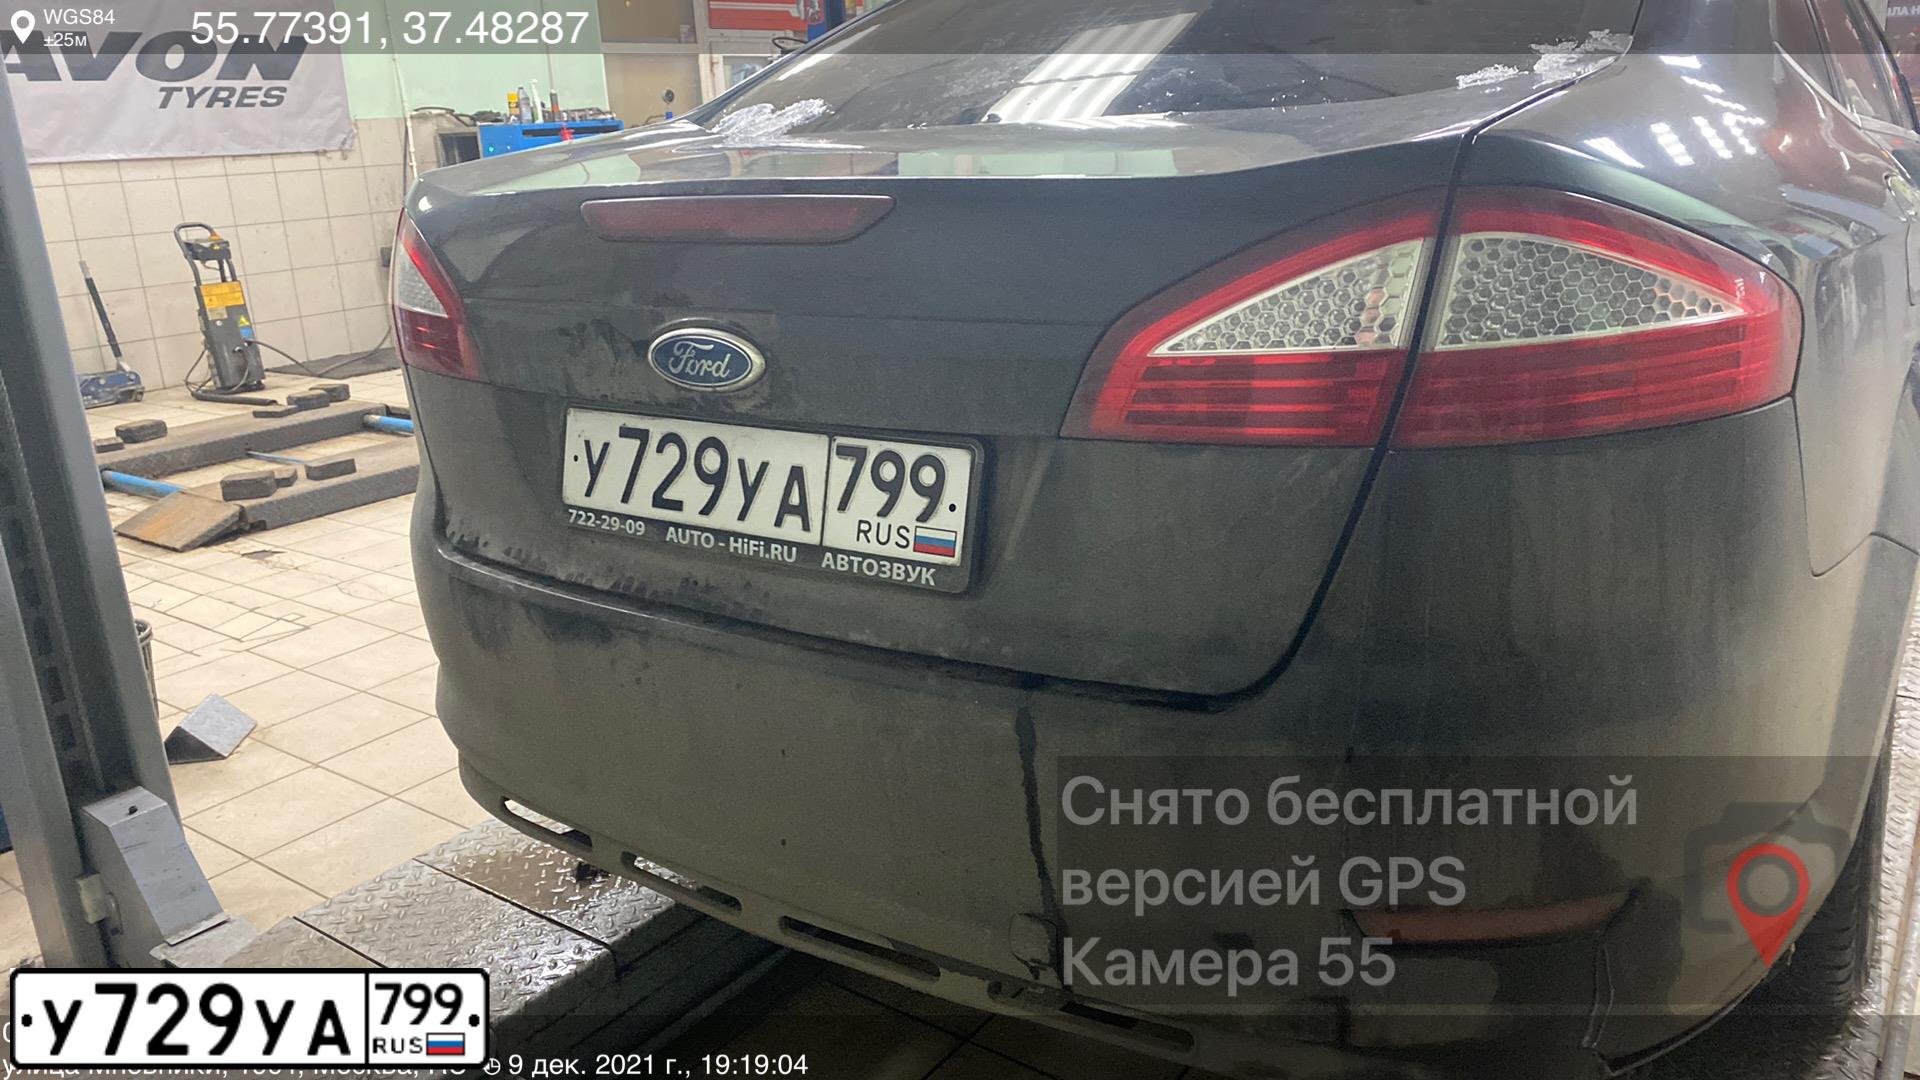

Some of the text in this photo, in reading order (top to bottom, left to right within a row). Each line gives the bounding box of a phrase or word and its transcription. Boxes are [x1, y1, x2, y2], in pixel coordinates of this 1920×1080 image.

[0, 30, 308, 82] AVON
[157, 86, 288, 110] TYRES
[667, 340, 731, 378] Ford
[583, 426, 947, 533] У729УА 799
[567, 509, 646, 536] 722-29-09
[665, 527, 714, 549] AUTO
[855, 520, 911, 549] RUS
[821, 551, 936, 586] АВТОЗВУК
